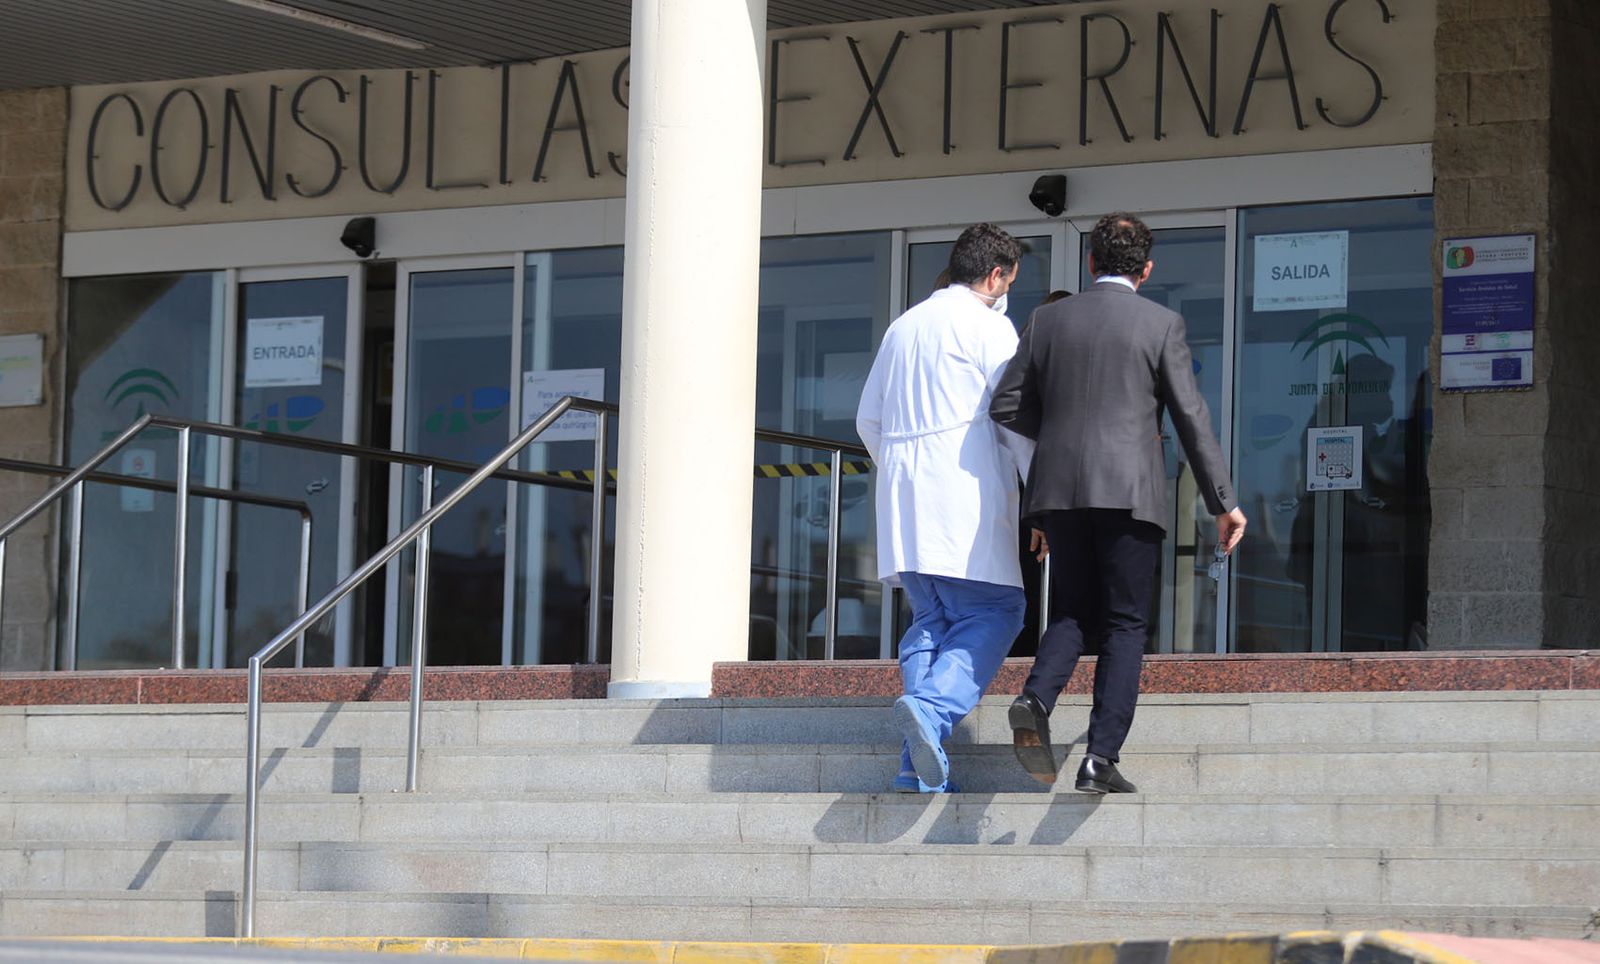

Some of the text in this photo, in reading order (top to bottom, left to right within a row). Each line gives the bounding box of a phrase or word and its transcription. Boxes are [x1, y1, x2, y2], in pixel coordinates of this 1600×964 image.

[768, 0, 1392, 166] EXTERNAS
[1271, 264, 1331, 281] SALIDA
[253, 345, 316, 361] ENTRADA
[1289, 383, 1318, 396] JUNTA
